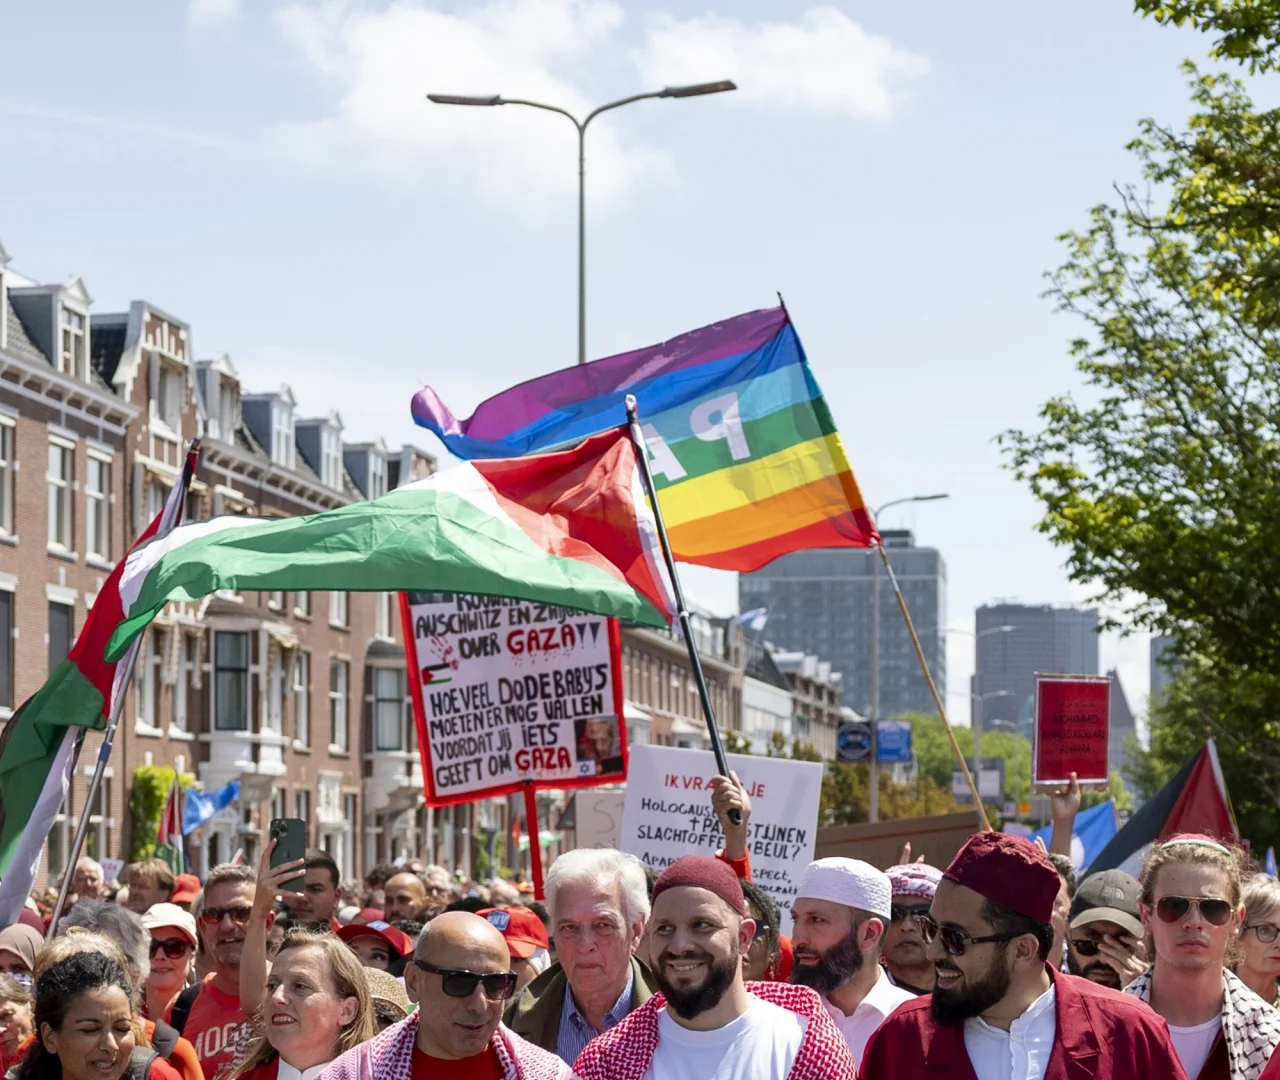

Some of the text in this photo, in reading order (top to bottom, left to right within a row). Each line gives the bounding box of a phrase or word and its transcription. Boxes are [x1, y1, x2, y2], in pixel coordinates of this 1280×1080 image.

[415, 609, 502, 639] AUSCHWITZ
[509, 606, 531, 625] EN
[458, 632, 501, 659] OVER
[429, 695, 604, 740] MOETEN ER NOG VALLEN
[432, 733, 496, 761] VOORDAT
[497, 730, 513, 752] JIJ
[435, 747, 572, 788] GEEFT OM GAZA
[664, 774, 766, 798] IK VRA JE
[637, 825, 801, 861] SLACHTOFFE BEUL?
